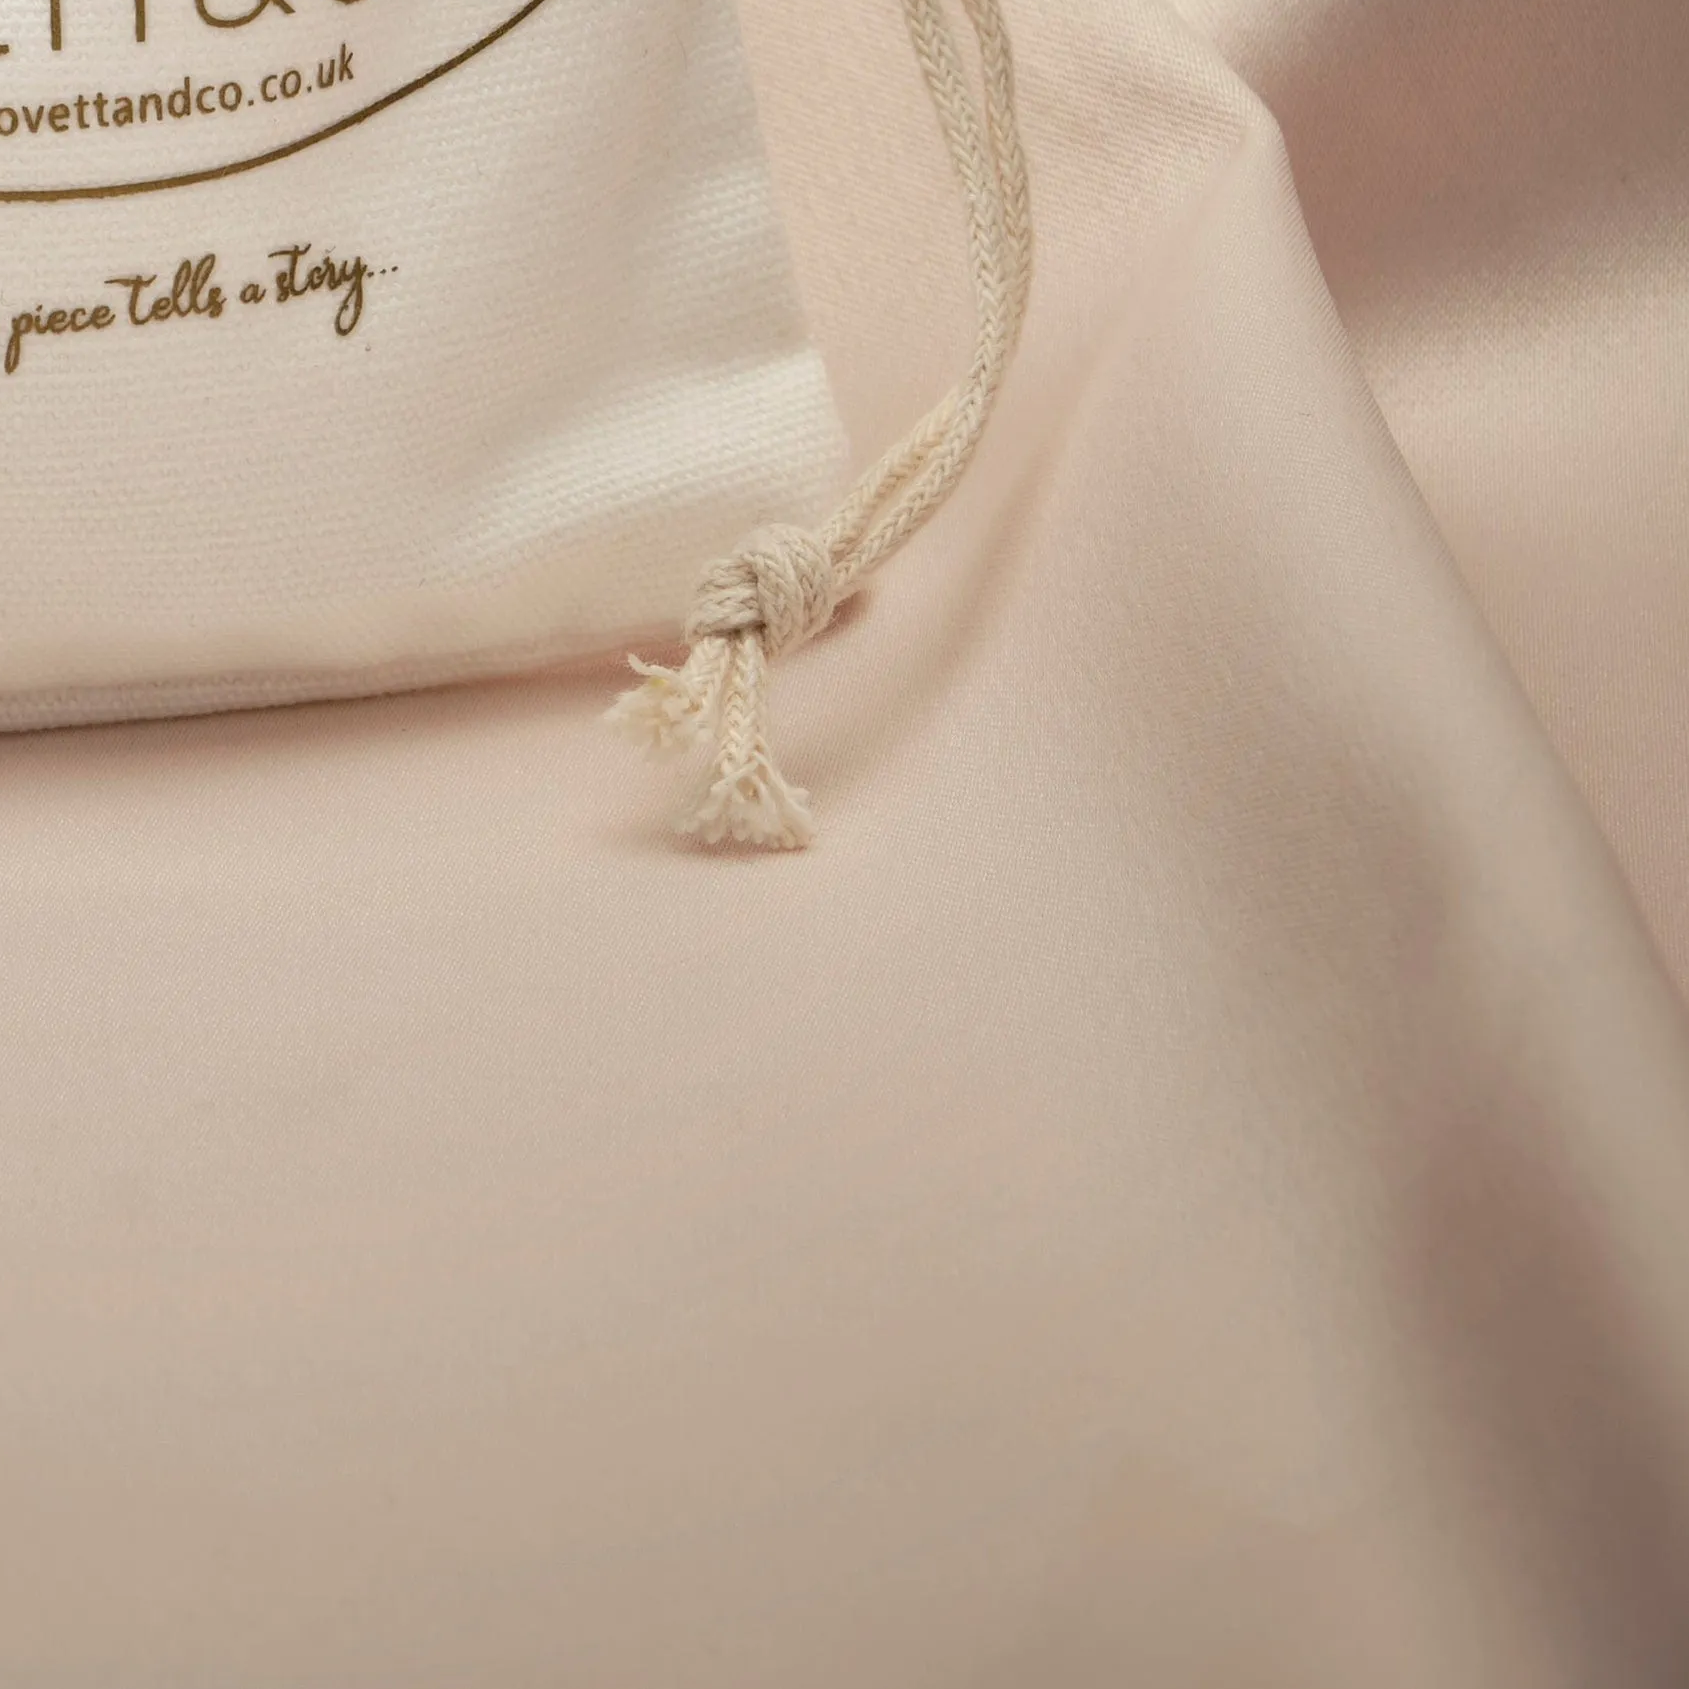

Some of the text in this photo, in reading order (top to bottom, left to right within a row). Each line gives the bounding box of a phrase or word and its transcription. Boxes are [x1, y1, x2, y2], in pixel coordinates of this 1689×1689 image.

[4, 303, 116, 376] piece
[103, 253, 228, 326] tells
[239, 283, 267, 305] a
[267, 243, 400, 337] story...
